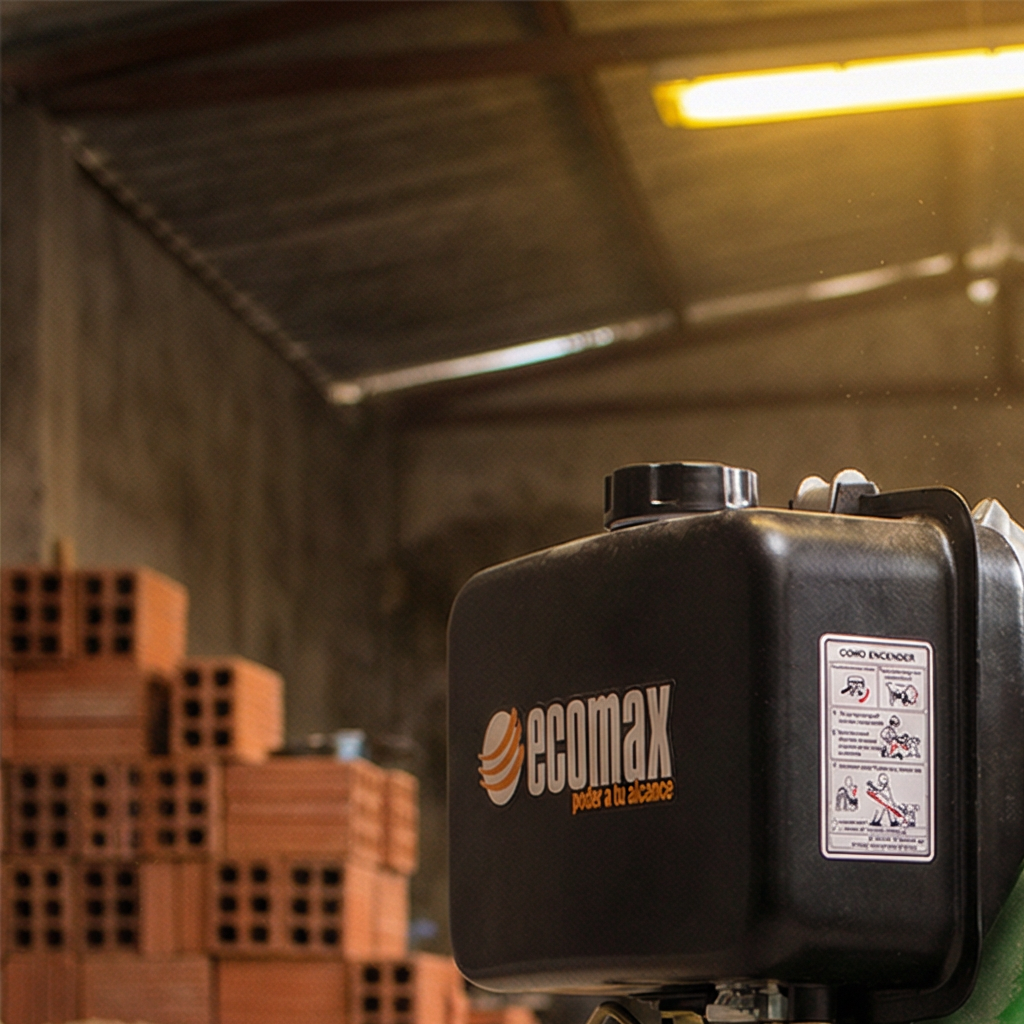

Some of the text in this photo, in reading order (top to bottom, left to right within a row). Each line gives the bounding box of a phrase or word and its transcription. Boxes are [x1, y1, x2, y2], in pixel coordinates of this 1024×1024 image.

[868, 650, 915, 662] ENCENDER
[526, 684, 672, 797] ecomax
[572, 780, 675, 815] poder a tu alcance
